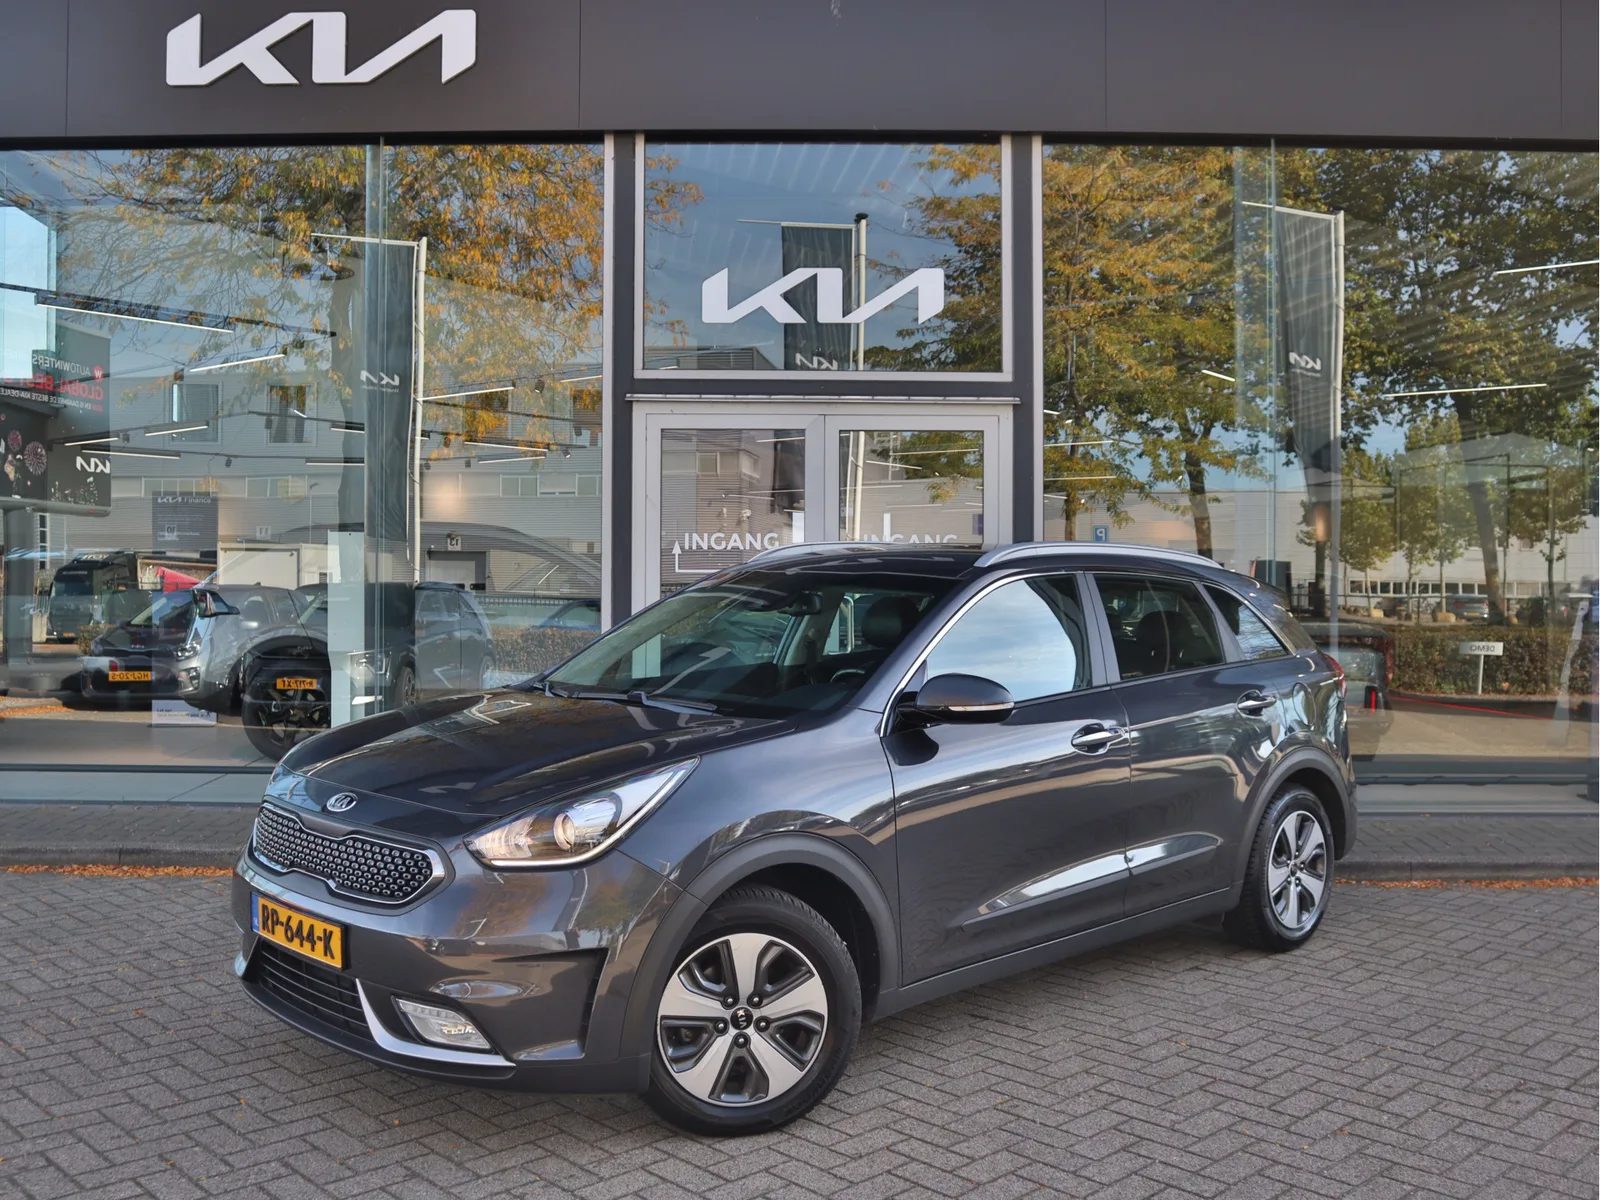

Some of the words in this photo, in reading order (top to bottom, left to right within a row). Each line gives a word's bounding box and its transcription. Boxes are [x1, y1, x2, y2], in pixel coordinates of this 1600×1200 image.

[165, 8, 477, 87] KIA
[701, 267, 945, 324] KIA
[184, 496, 212, 504] Finance
[684, 532, 779, 550] INGANG
[261, 903, 335, 960] RP-644-K
